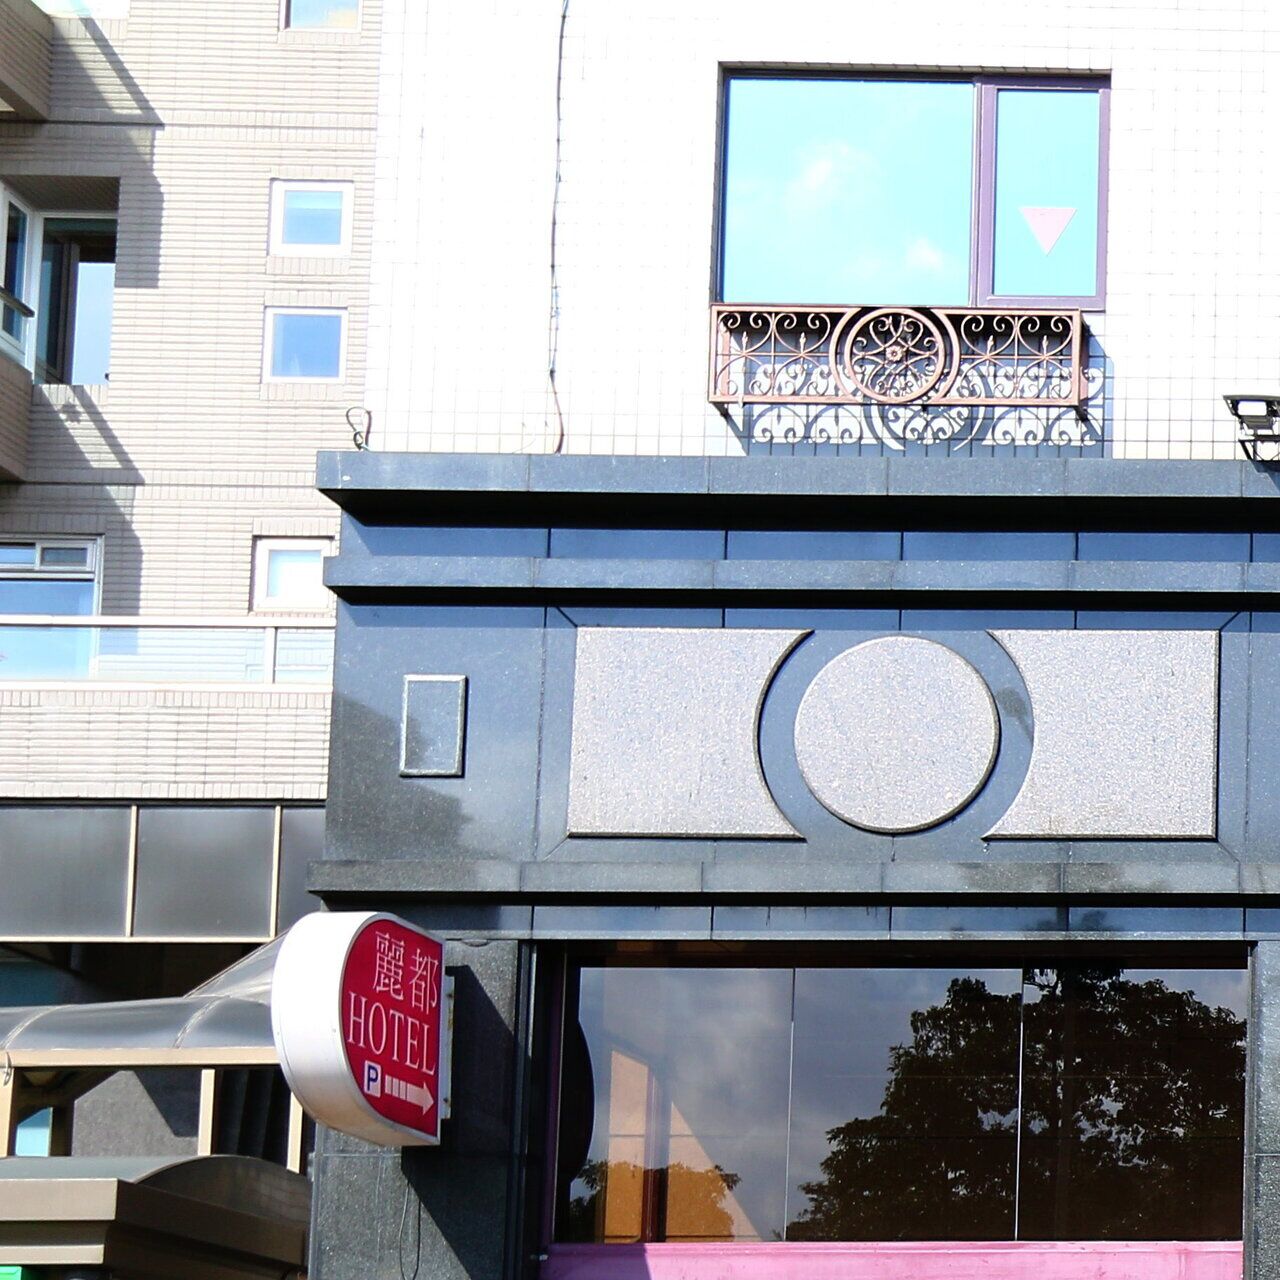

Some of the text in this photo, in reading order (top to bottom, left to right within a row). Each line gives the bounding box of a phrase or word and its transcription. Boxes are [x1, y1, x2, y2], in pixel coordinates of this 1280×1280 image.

[373, 930, 439, 1015] 麗都
[348, 991, 436, 1076] HOTEL
[367, 1065, 379, 1092] P
